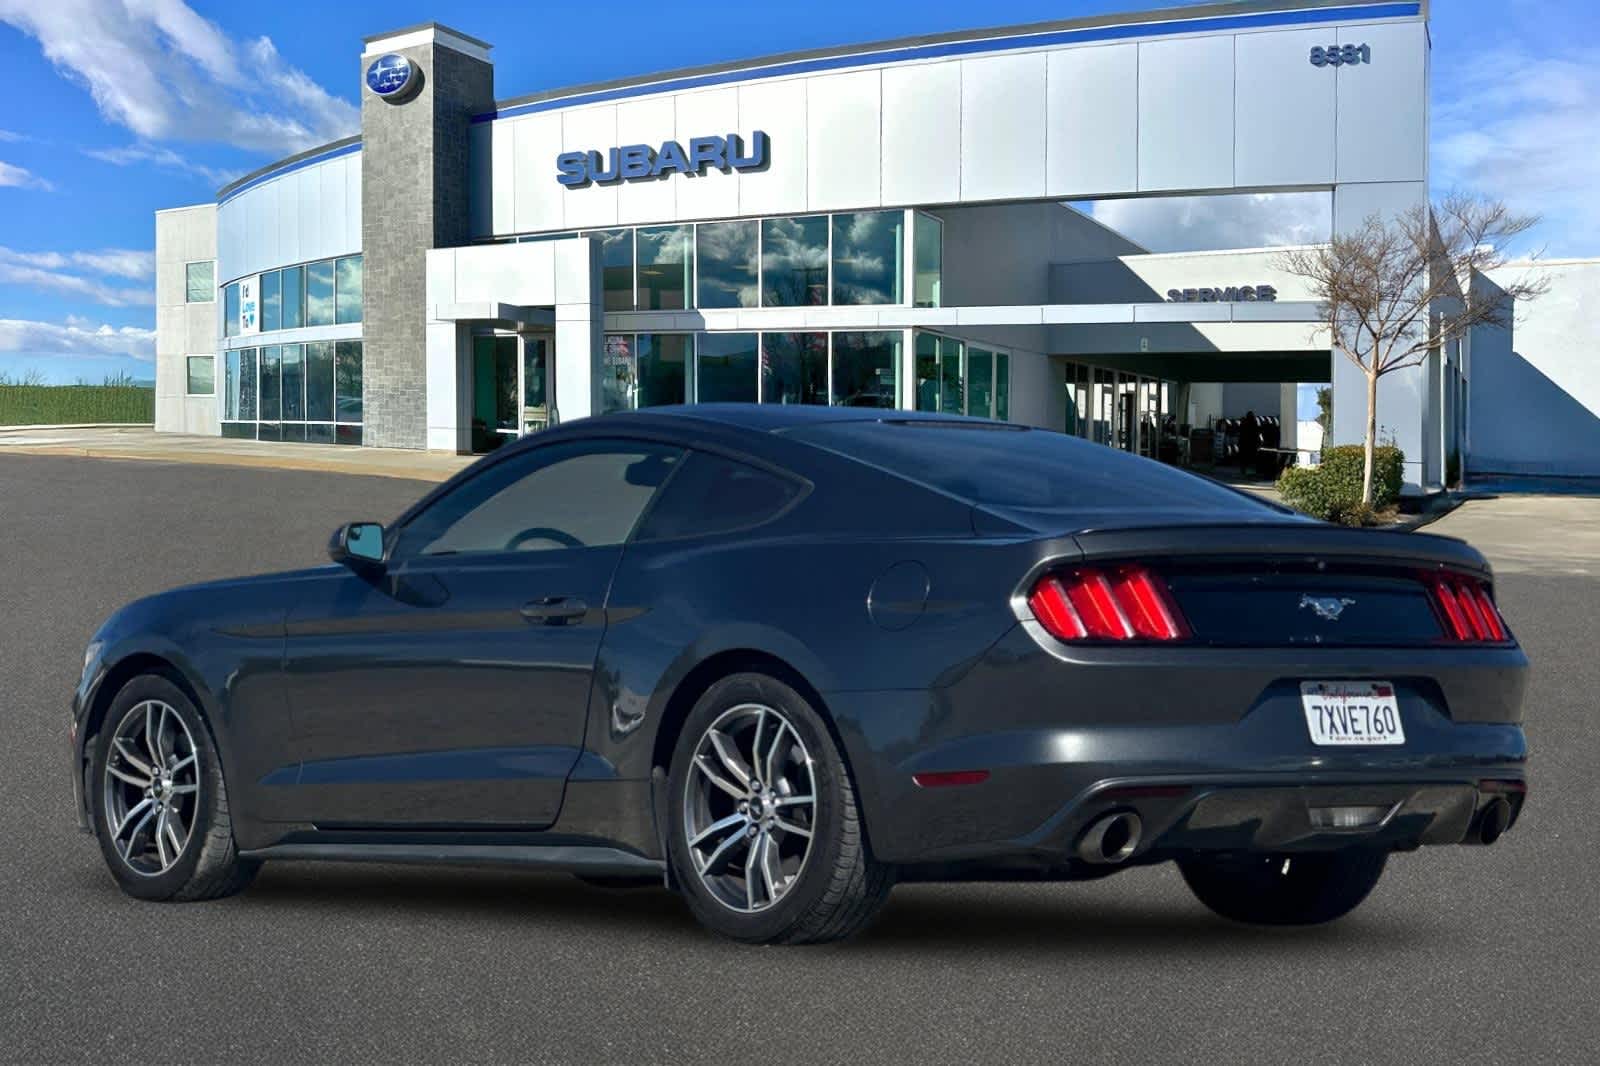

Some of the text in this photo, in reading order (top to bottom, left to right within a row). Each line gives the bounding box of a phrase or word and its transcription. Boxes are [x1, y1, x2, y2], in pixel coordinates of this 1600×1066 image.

[556, 130, 770, 189] SUBARU
[1167, 285, 1277, 302] SERVICE
[1312, 705, 1396, 735] 7XVE760
